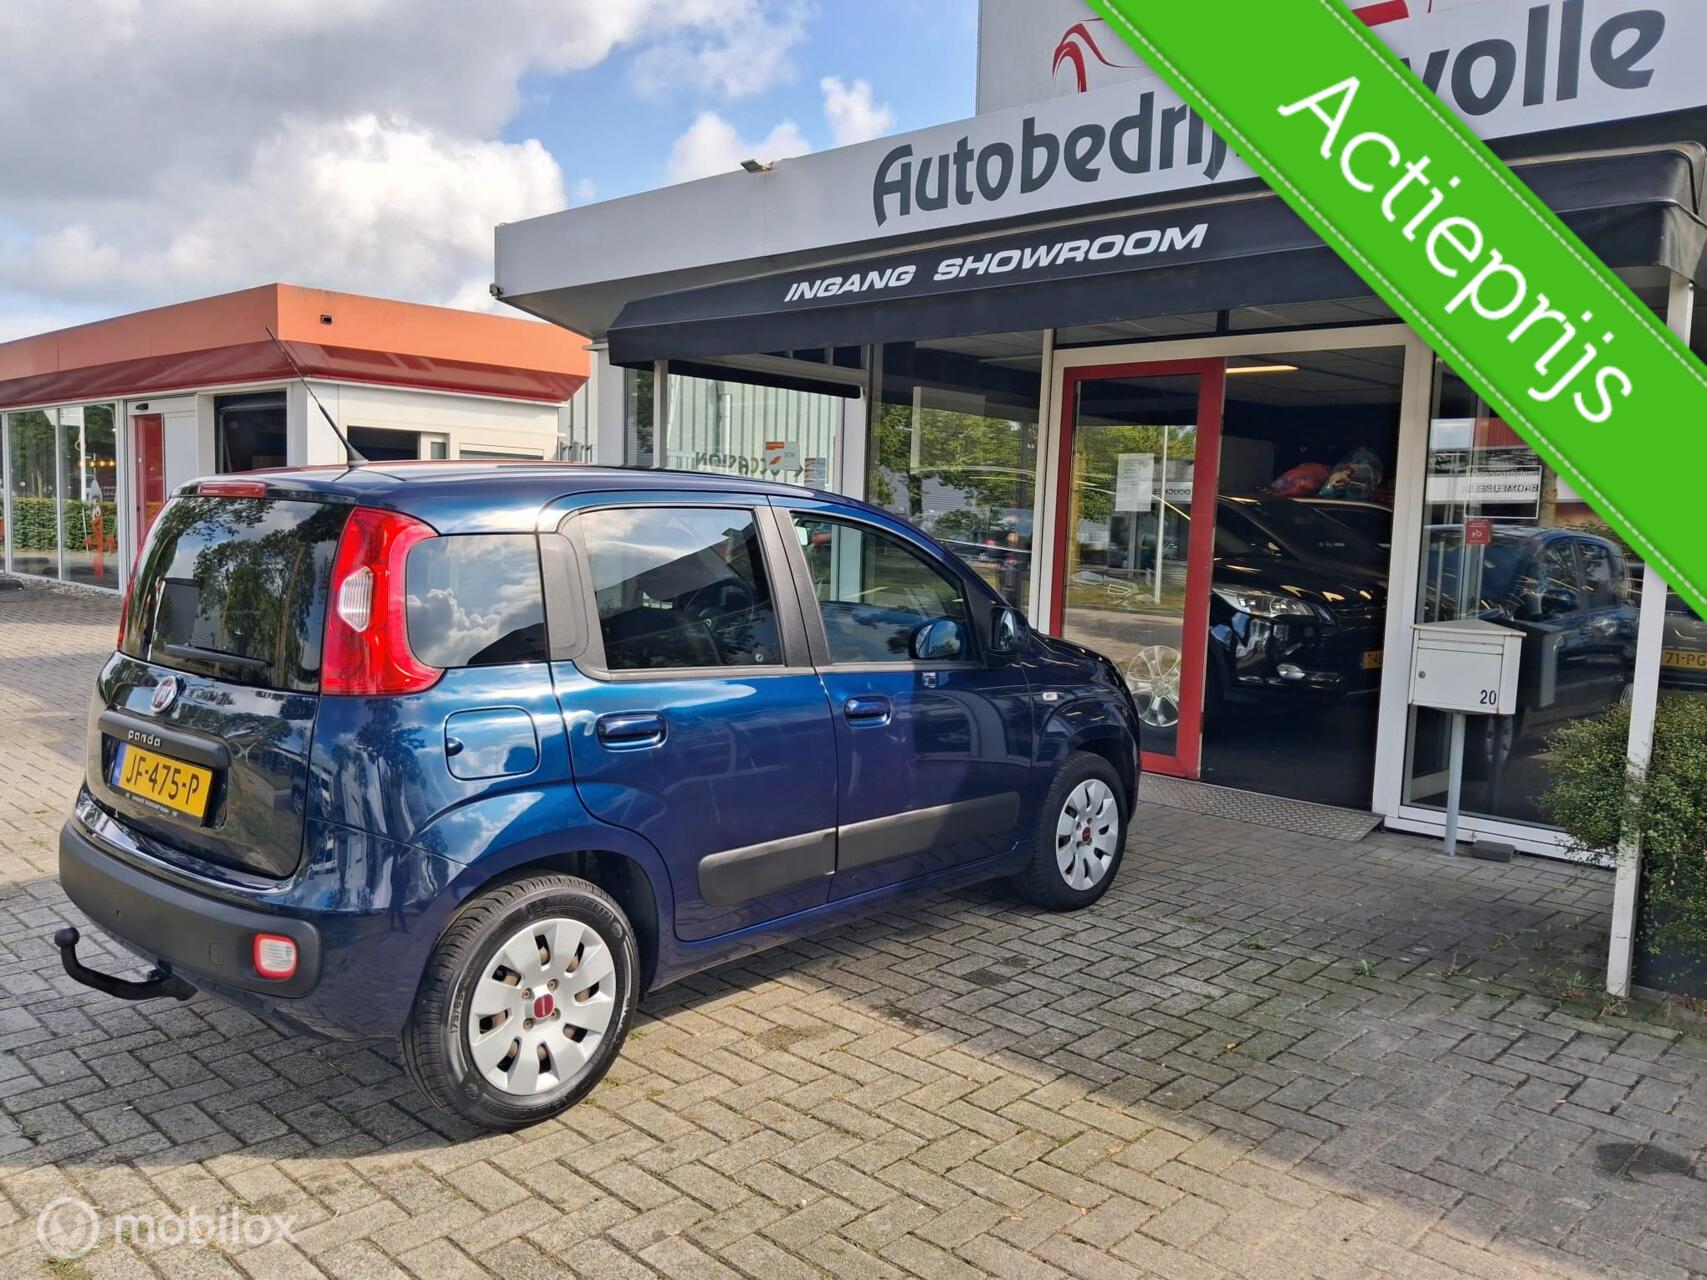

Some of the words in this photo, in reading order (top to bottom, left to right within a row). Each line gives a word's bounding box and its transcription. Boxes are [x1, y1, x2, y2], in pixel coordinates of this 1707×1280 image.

[872, 91, 1242, 228] Autobedrij
[783, 265, 916, 301] INGANG
[933, 223, 1209, 281] SHOWROOM
[1480, 690, 1497, 705] 20
[128, 730, 161, 747] panda
[126, 754, 200, 805] JF-475-P
